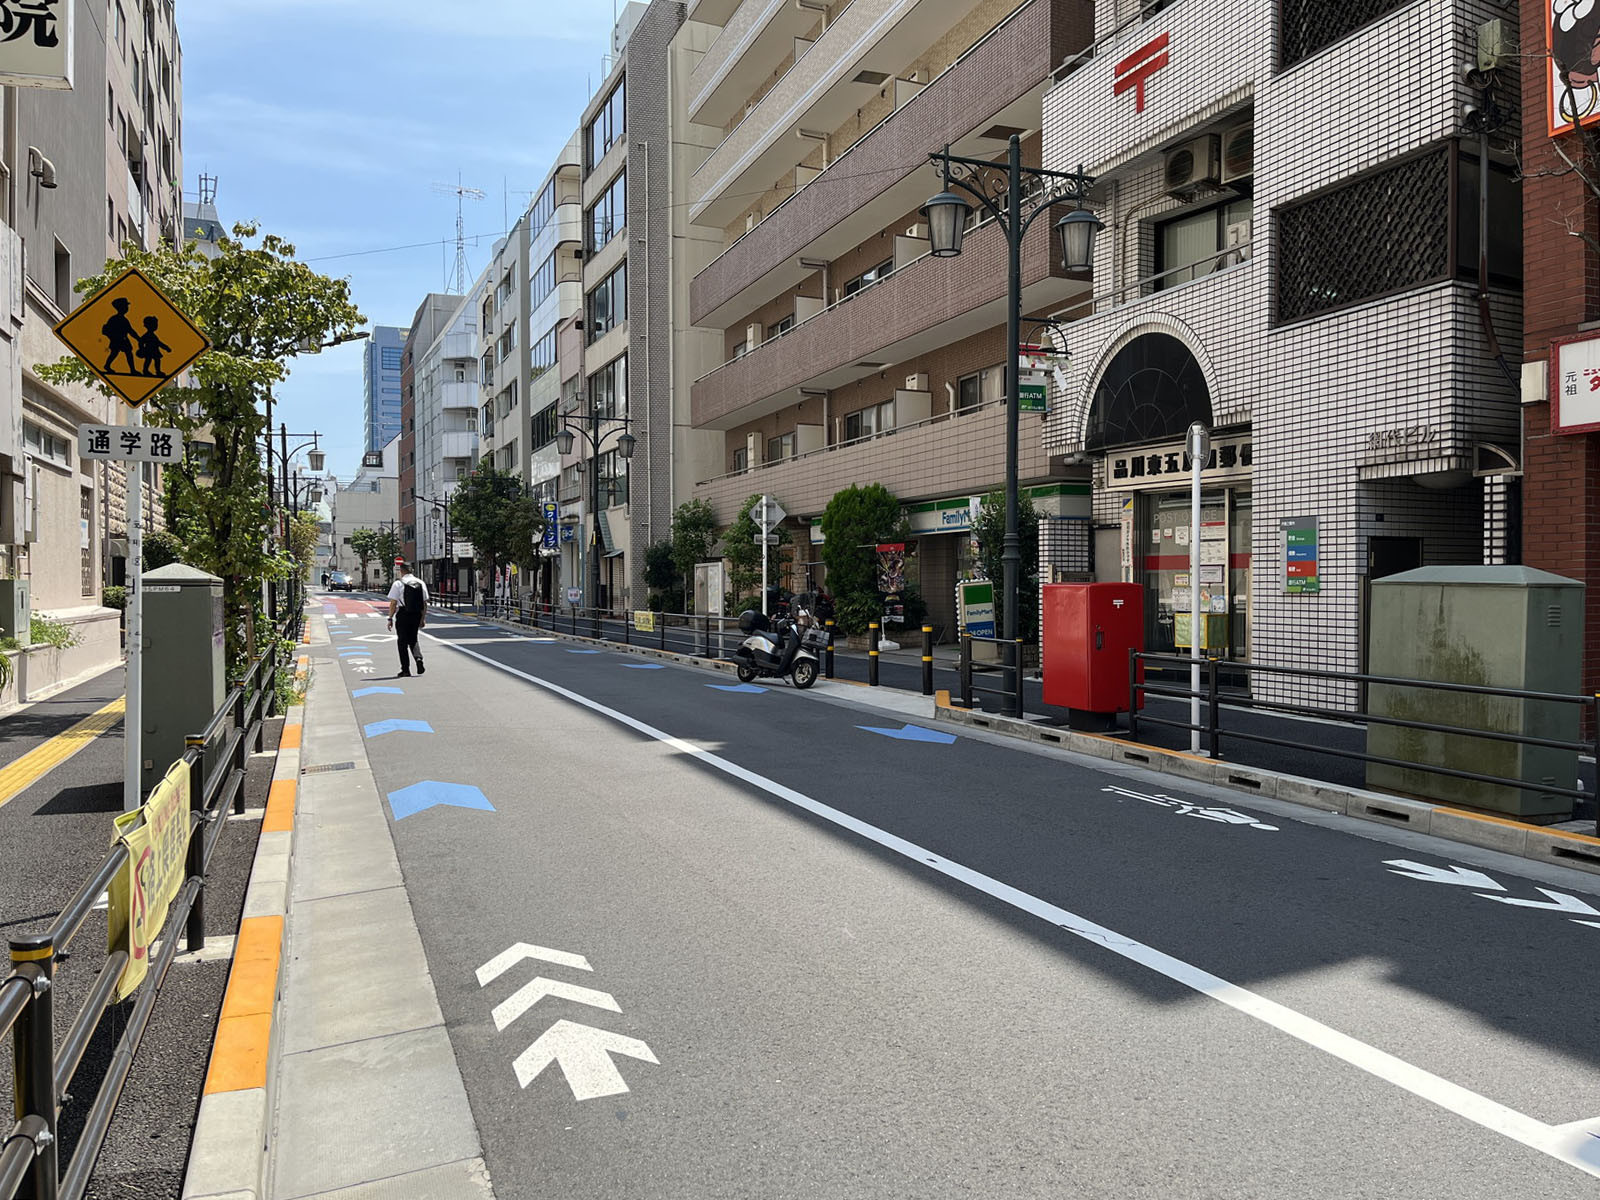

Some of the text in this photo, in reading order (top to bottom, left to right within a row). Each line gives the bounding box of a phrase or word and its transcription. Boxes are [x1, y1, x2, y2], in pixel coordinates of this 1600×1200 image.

[1565, 371, 1578, 396] 元祖
[87, 429, 173, 457] 通学路
[966, 609, 993, 617] FamilyMart
